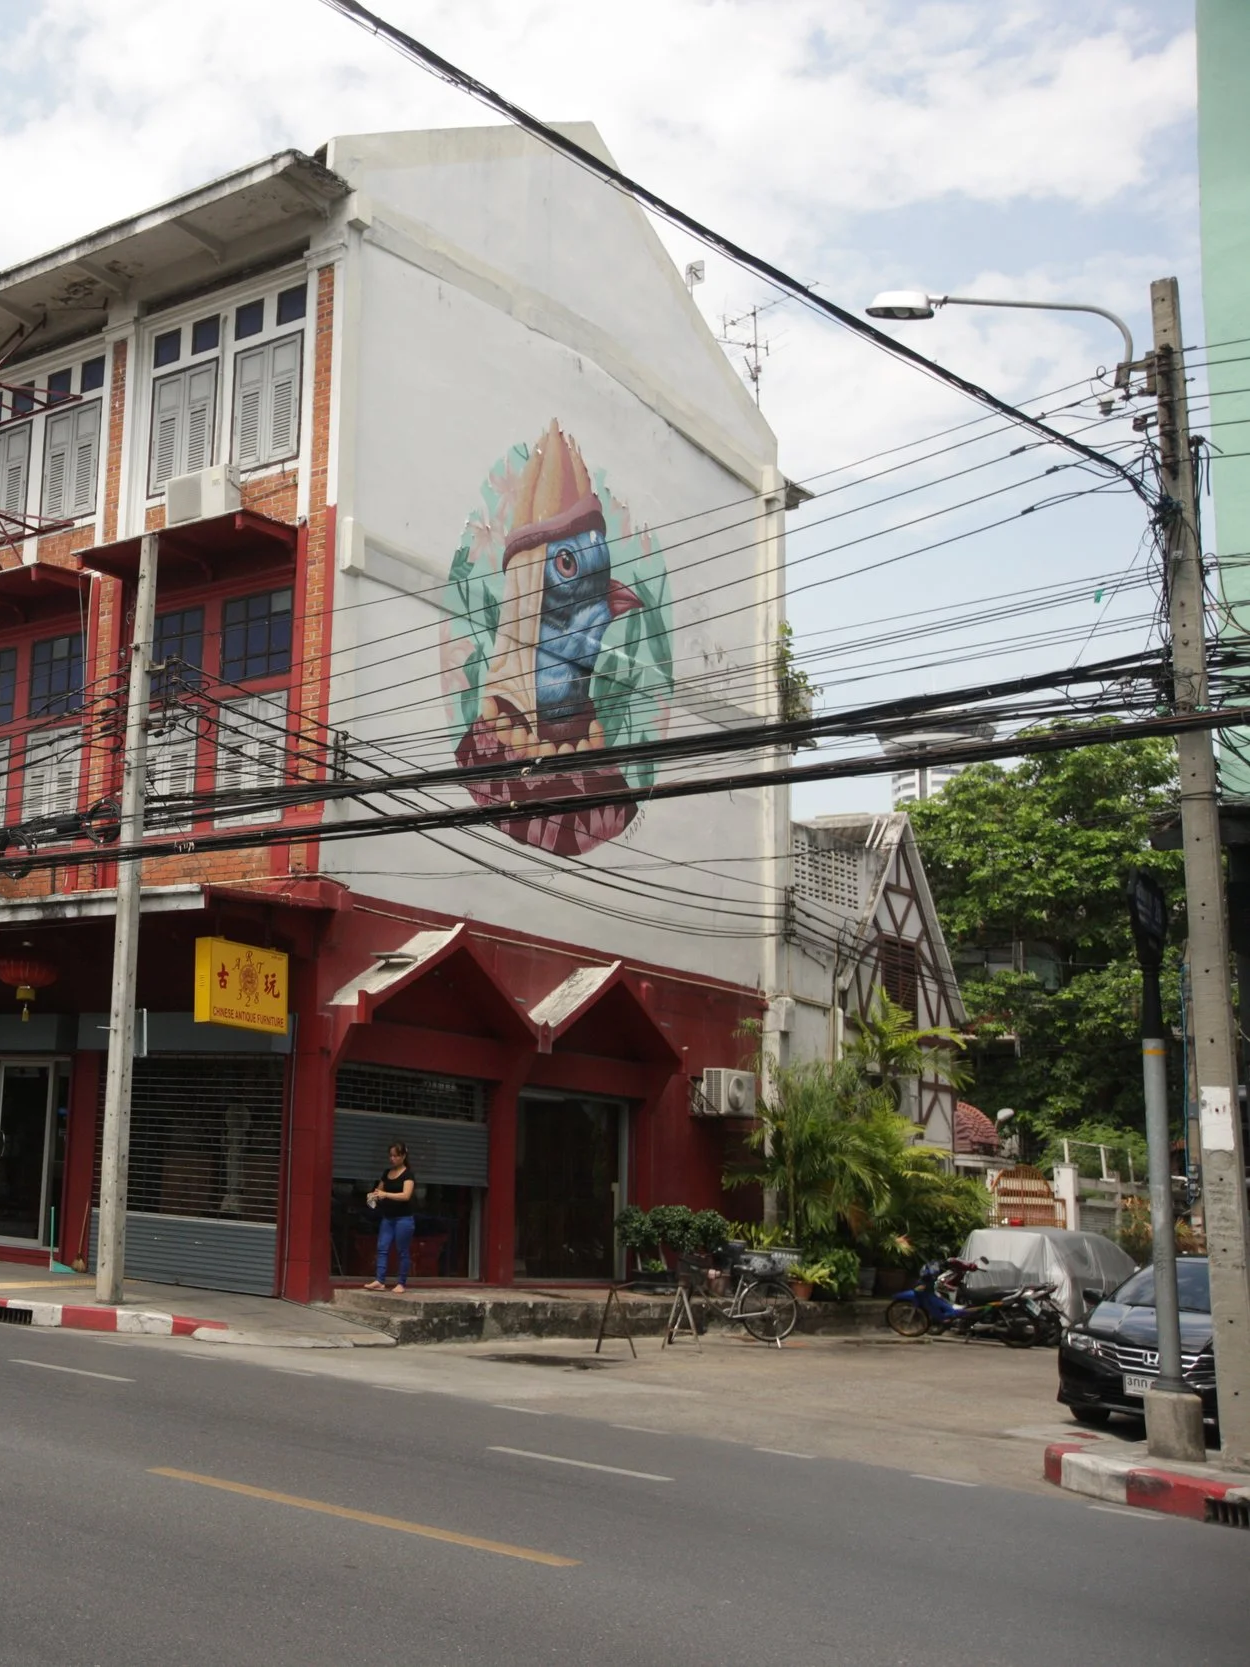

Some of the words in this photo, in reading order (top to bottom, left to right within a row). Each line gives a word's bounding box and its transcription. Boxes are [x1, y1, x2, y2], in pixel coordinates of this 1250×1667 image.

[231, 950, 265, 974] ART
[217, 961, 230, 990] 古
[264, 973, 280, 999] 玩
[236, 989, 260, 1008] 328
[213, 1006, 234, 1019] CHINESE
[235, 1010, 257, 1024] ANTIQUE
[257, 1014, 285, 1029] FURNITURE
